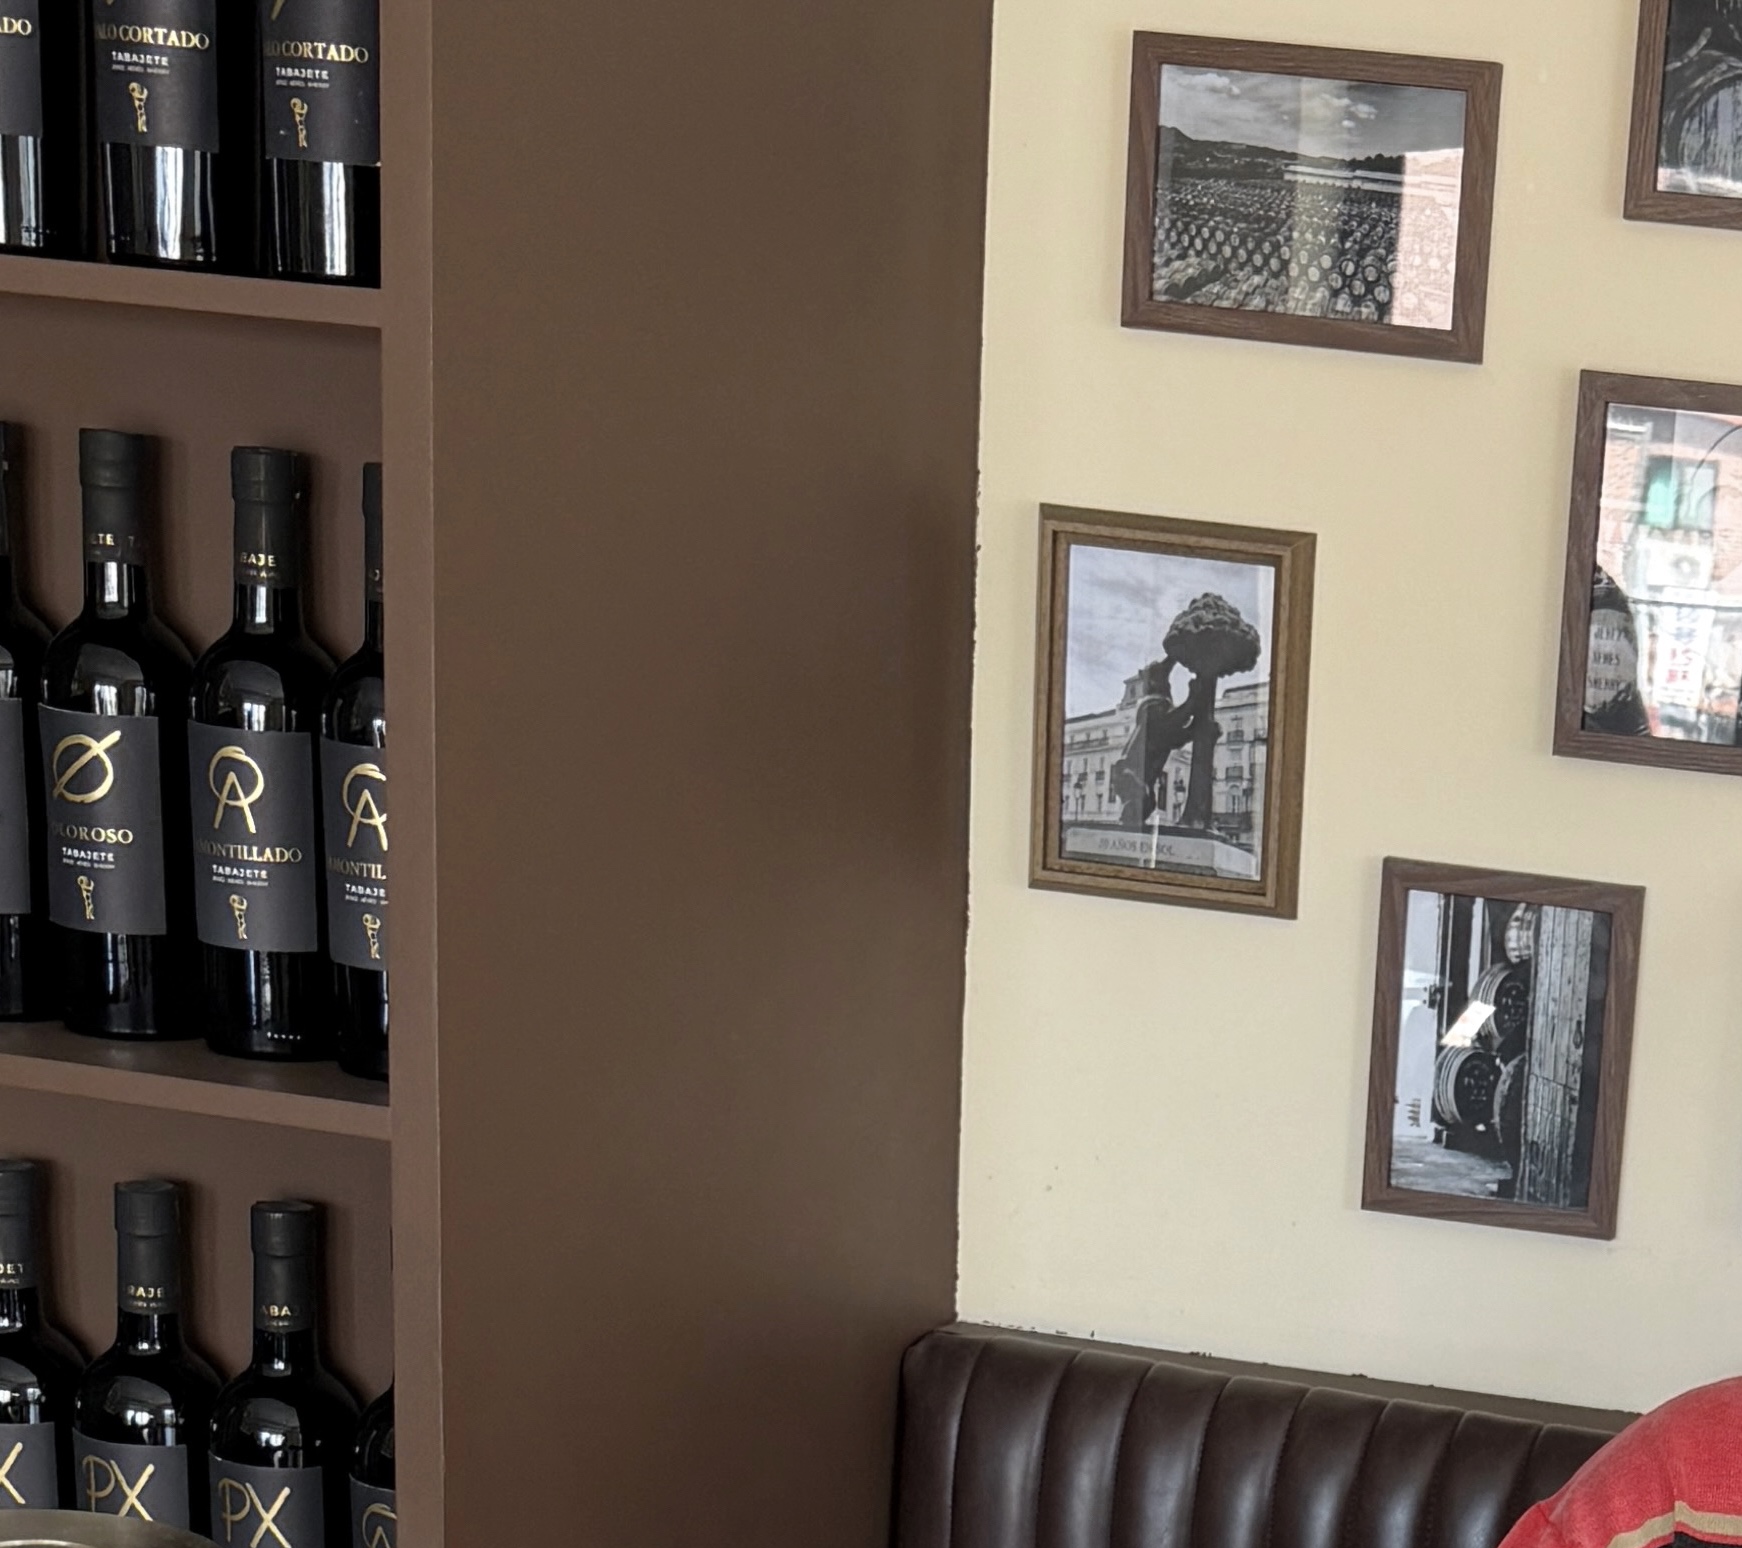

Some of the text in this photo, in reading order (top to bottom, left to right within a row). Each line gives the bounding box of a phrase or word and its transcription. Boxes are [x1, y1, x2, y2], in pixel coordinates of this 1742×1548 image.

[118, 25, 210, 50] CORTADO
[111, 51, 169, 67] TABAJETE
[281, 41, 369, 64] CORTADO
[62, 846, 115, 863] TABAJETE
[212, 864, 268, 880] TABAJETE
[345, 883, 386, 898] TABAJE
